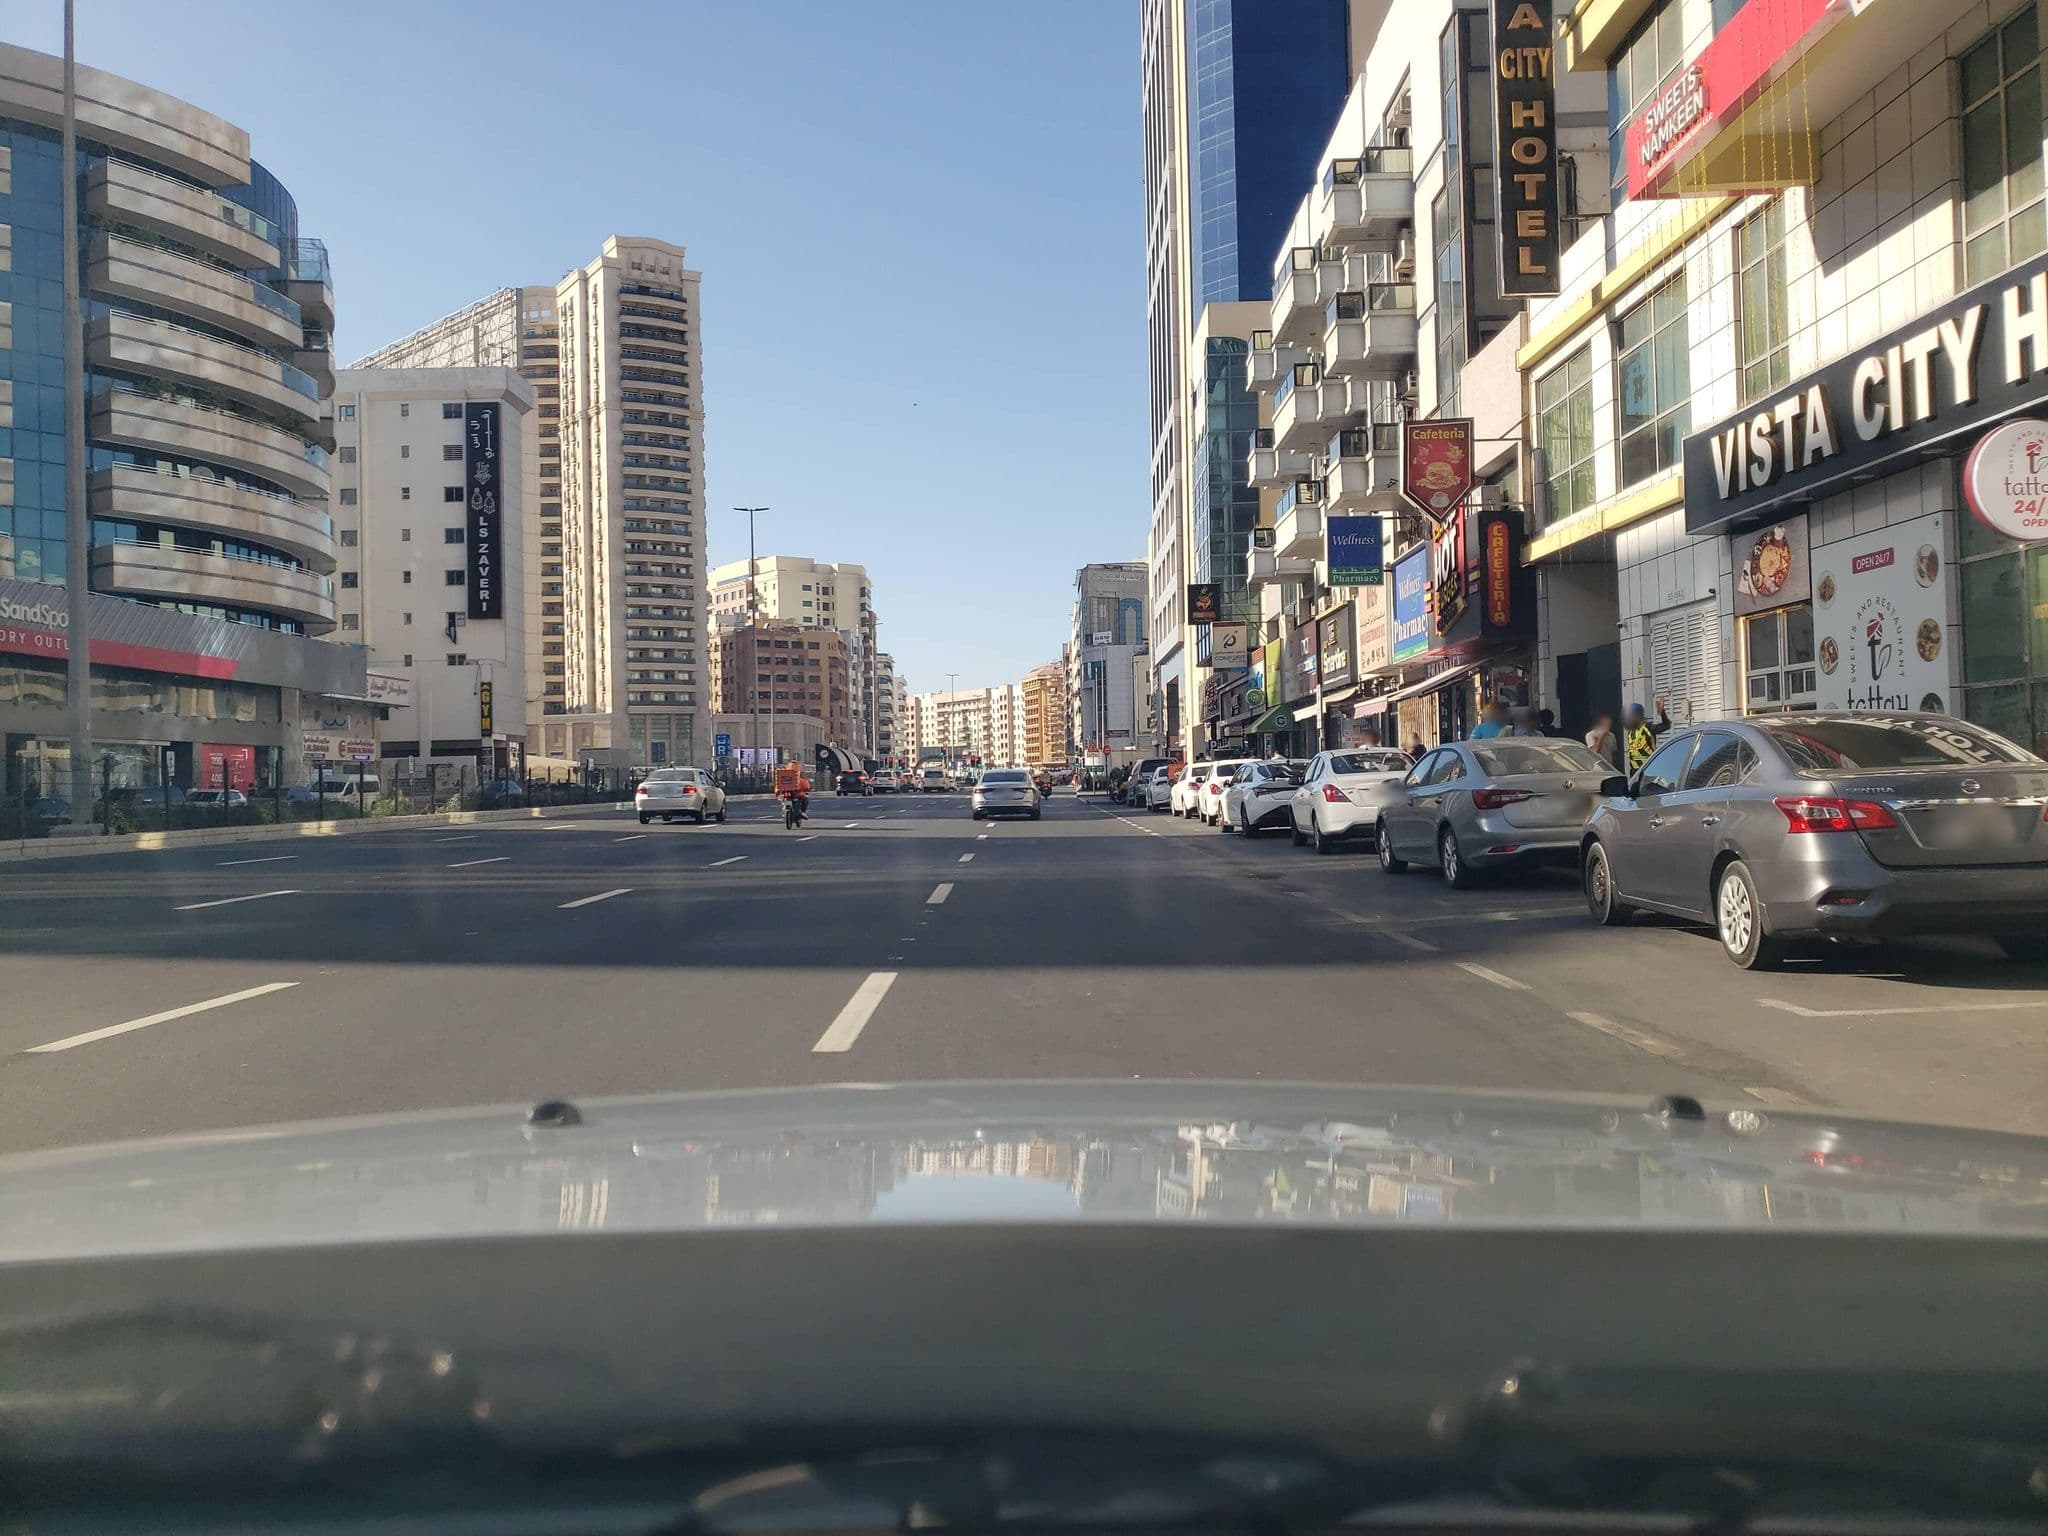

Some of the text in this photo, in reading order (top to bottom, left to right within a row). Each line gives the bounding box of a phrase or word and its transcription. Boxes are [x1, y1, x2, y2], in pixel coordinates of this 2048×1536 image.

[1500, 47, 1551, 79] CITY
[1646, 65, 1696, 133] SWEETS
[1642, 85, 1703, 166] NAMKEEN
[1511, 100, 1547, 274] HOTEL
[1710, 384, 1839, 500] VISTA
[1853, 304, 1989, 441] CITY
[1412, 427, 1465, 440] Cafeteria
[2014, 497, 2048, 517] 24/
[1332, 533, 1376, 546] Wellness
[1435, 524, 1457, 593] HOT
[1856, 551, 1890, 570] OPEN 24/7
[479, 543, 489, 612] ZAVERI
[1332, 574, 1379, 584] Pharmacy
[1493, 525, 1506, 623] CAFETERIA
[1857, 599, 1872, 620] AND
